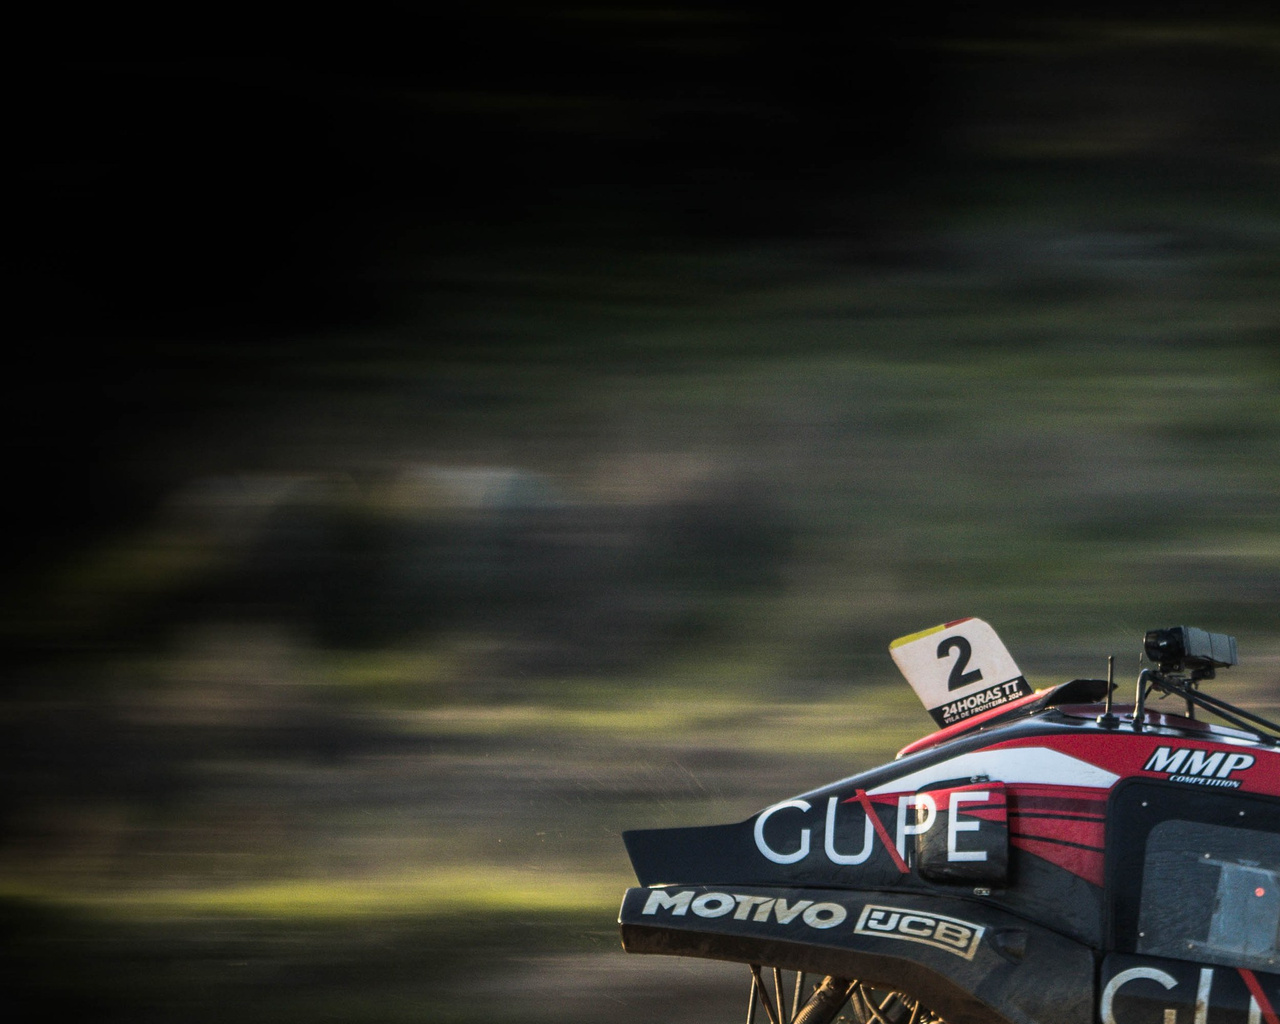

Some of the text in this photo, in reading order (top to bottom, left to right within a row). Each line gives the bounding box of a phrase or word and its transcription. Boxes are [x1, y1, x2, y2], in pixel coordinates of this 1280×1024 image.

[937, 636, 983, 692] 2
[1002, 680, 1018, 695] TT
[944, 691, 1023, 724] VILA DE FRONTEIRA 2024
[1143, 746, 1255, 778] MMP
[1169, 774, 1241, 789] COMPETITION
[642, 890, 972, 949] MOTIVO JCB
